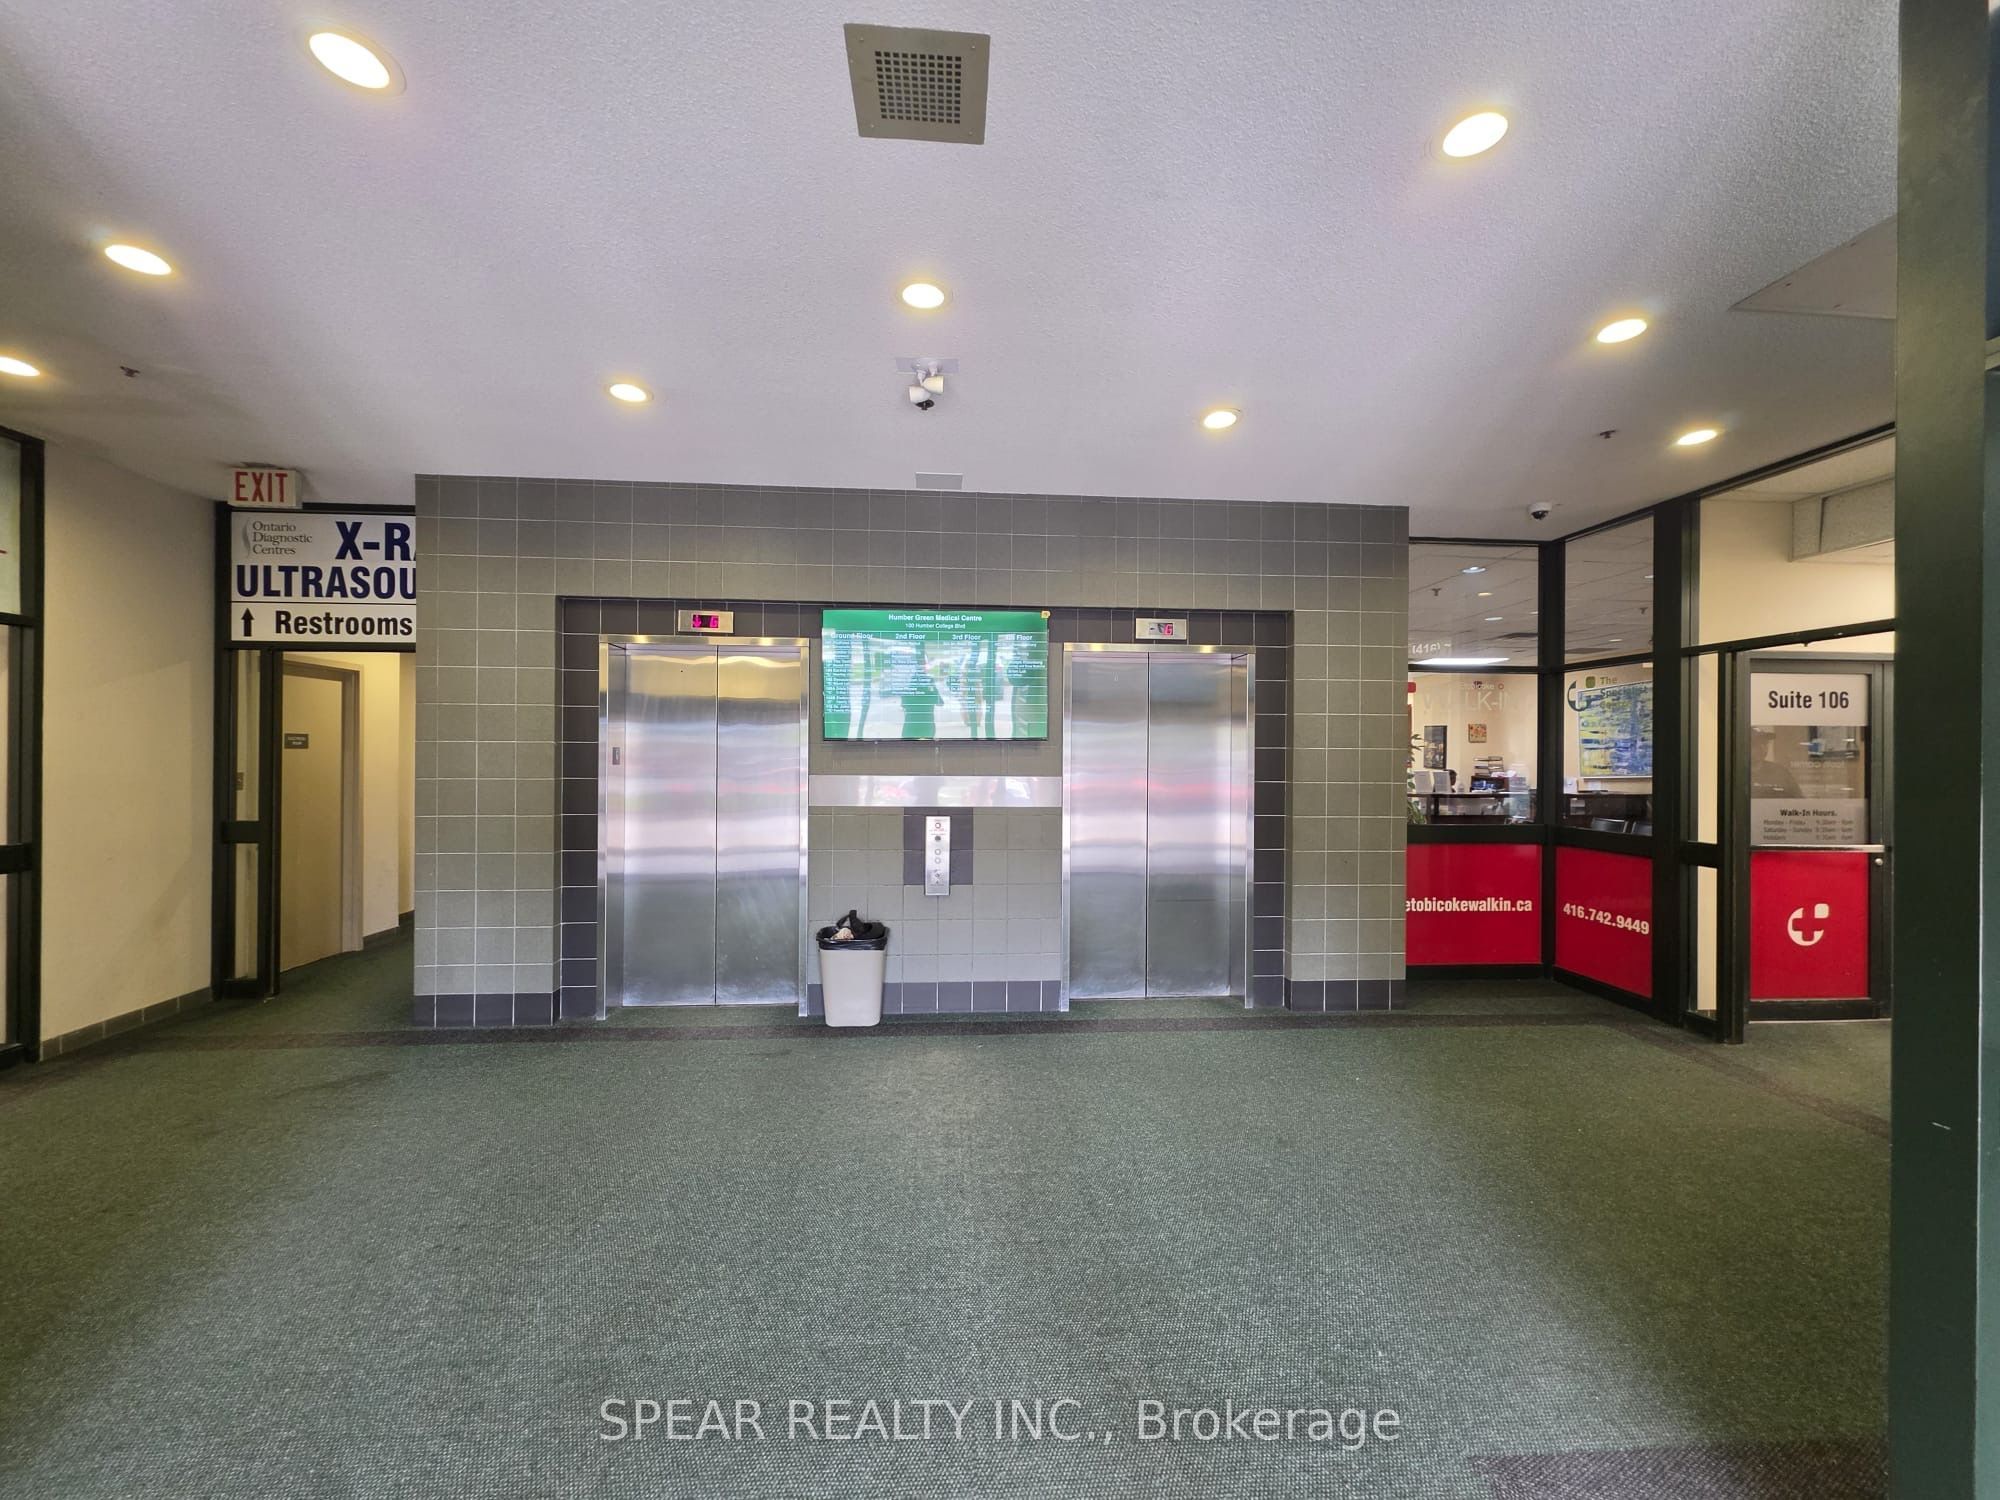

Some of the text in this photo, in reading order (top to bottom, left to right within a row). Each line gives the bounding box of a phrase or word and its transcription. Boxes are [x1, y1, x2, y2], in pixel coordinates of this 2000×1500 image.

[235, 471, 288, 503] EXIT
[252, 521, 297, 532] Ontario
[252, 533, 313, 545] Diagnostic
[335, 521, 416, 561] X-R
[252, 544, 297, 555] Centres
[236, 565, 416, 600] ULTRASOU
[275, 610, 413, 636] Restrooms
[1768, 690, 1849, 709] Suite 106
[1780, 809, 1811, 817] Walk-In
[1406, 897, 1533, 912] etobicokewalkin.ca
[1563, 903, 1650, 935] 416.742.9449
